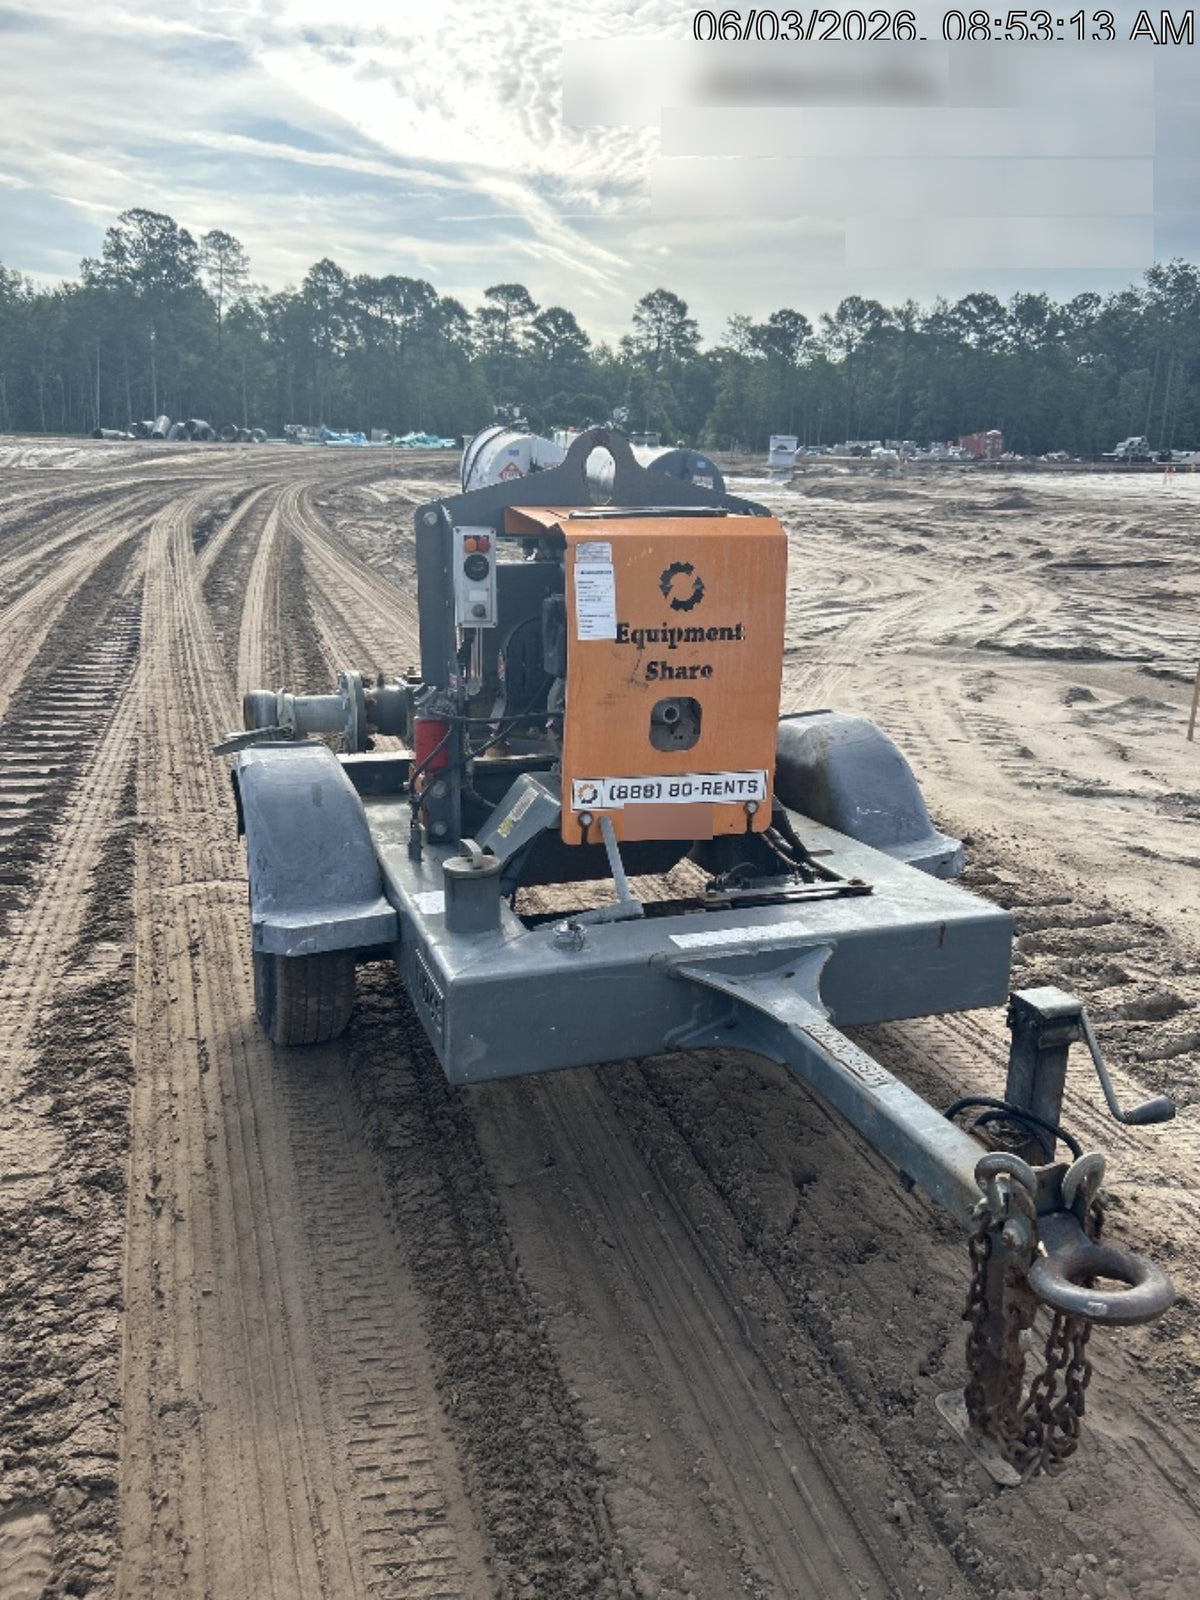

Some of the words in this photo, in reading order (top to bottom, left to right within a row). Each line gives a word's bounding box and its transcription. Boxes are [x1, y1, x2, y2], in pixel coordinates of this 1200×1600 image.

[615, 622, 744, 649] Equipment
[644, 660, 714, 682] Share
[609, 783, 662, 801] (888)
